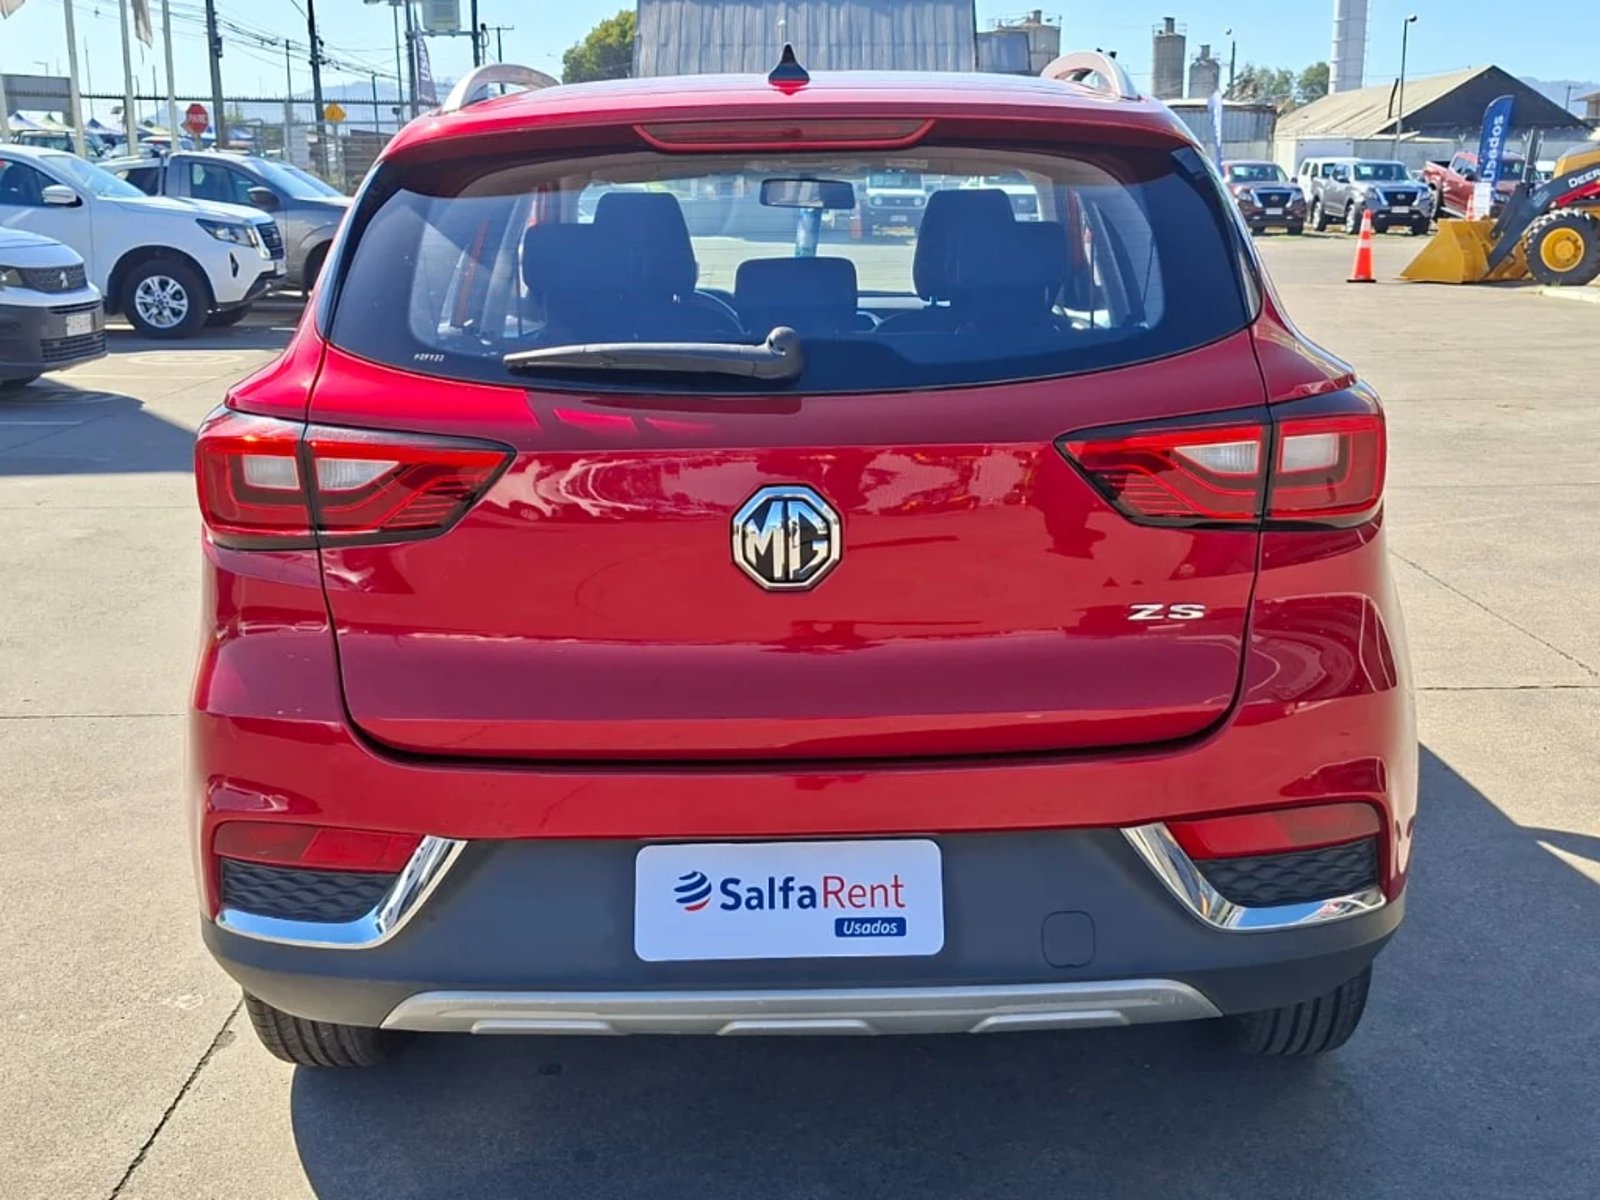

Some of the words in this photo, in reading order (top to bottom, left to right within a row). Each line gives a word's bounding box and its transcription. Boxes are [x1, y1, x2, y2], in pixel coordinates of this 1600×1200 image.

[1481, 115, 1504, 182] Usados
[744, 500, 829, 581] MG
[1127, 604, 1206, 621] ZS
[719, 875, 906, 912] SalfaRent
[842, 919, 899, 936] Usados
